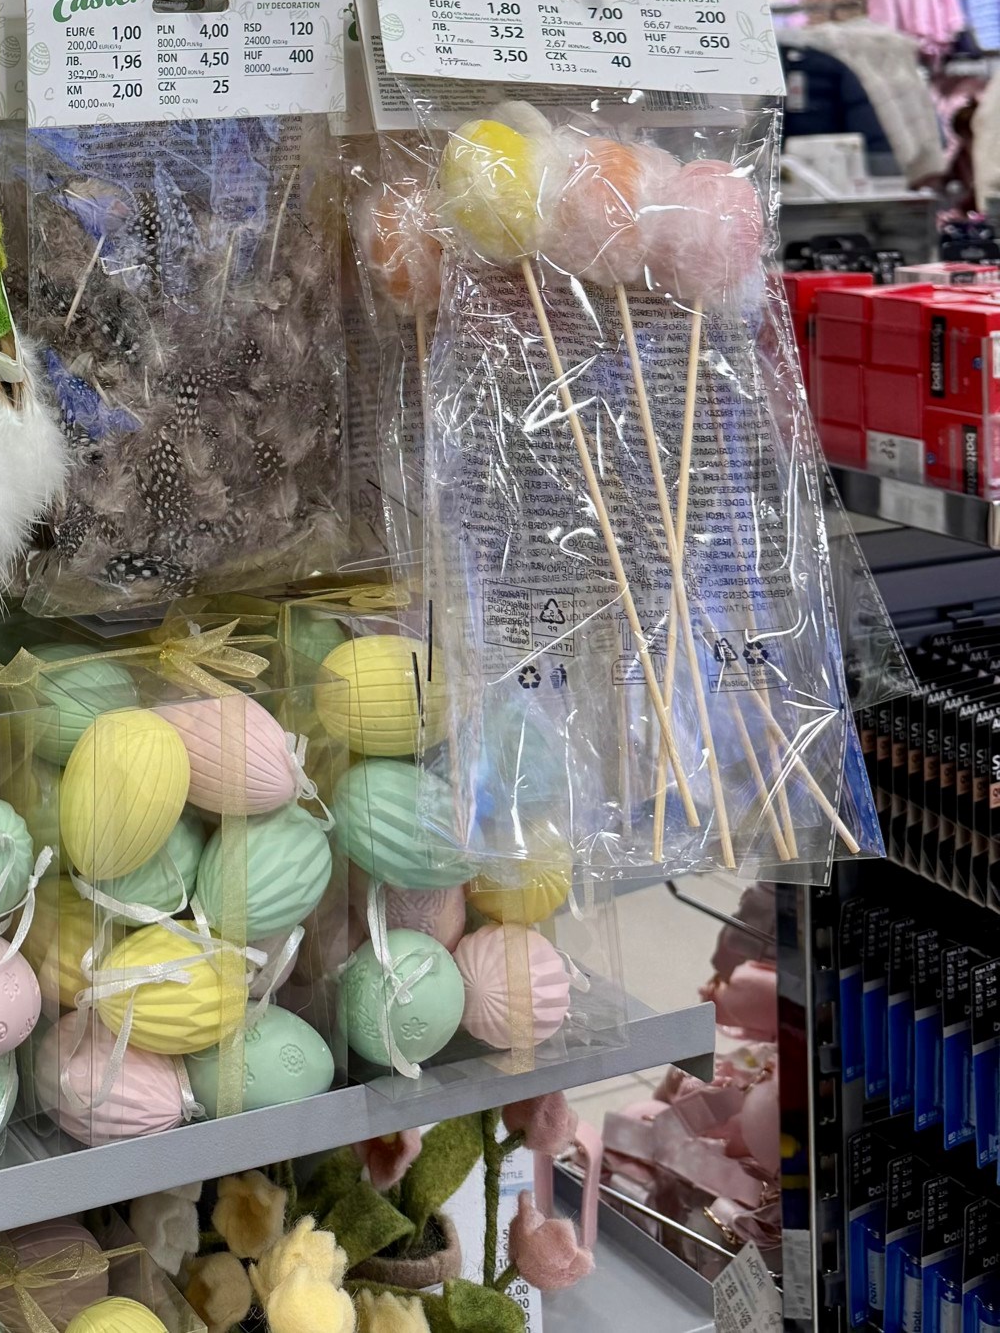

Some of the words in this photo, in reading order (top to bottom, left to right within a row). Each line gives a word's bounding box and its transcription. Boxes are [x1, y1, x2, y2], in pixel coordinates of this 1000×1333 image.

[429, 0, 461, 8] EUR/€
[487, 2, 520, 15] 1,80
[538, 5, 558, 13] PLN
[588, 7, 623, 20] 7,00
[640, 9, 661, 17] RSD
[695, 11, 725, 24] 200
[157, 25, 175, 34] PLN
[200, 24, 228, 39] 4,00
[244, 23, 262, 32] RSD
[290, 22, 313, 35] 120
[432, 23, 450, 31] ЛВ.
[490, 26, 524, 39] 3,52
[644, 21, 670, 29] 66,67
[66, 27, 95, 36] EUR/€
[112, 26, 141, 42] 1,00
[245, 36, 270, 45] 24000
[542, 28, 565, 36] RON
[593, 31, 627, 44] 8,00
[645, 33, 666, 41] HUF
[700, 36, 730, 48] 650
[67, 41, 98, 51] 200,00
[158, 38, 186, 48] 800,00
[648, 45, 681, 54] 216,67
[158, 54, 178, 62] RON
[200, 52, 229, 67] 4,50
[244, 51, 262, 59] HUF
[289, 49, 313, 62] 400
[436, 46, 452, 54] KM
[493, 49, 527, 62] 3,50
[545, 52, 567, 60] CZK
[611, 55, 631, 68] 40
[66, 57, 82, 66] ЛВ.
[112, 54, 142, 71] 1,96
[158, 67, 187, 77] 900,00
[67, 86, 82, 95] KM
[112, 83, 143, 100] 2,00
[158, 82, 176, 91] CZK
[213, 80, 229, 93] 25
[68, 99, 99, 109] 400,00
